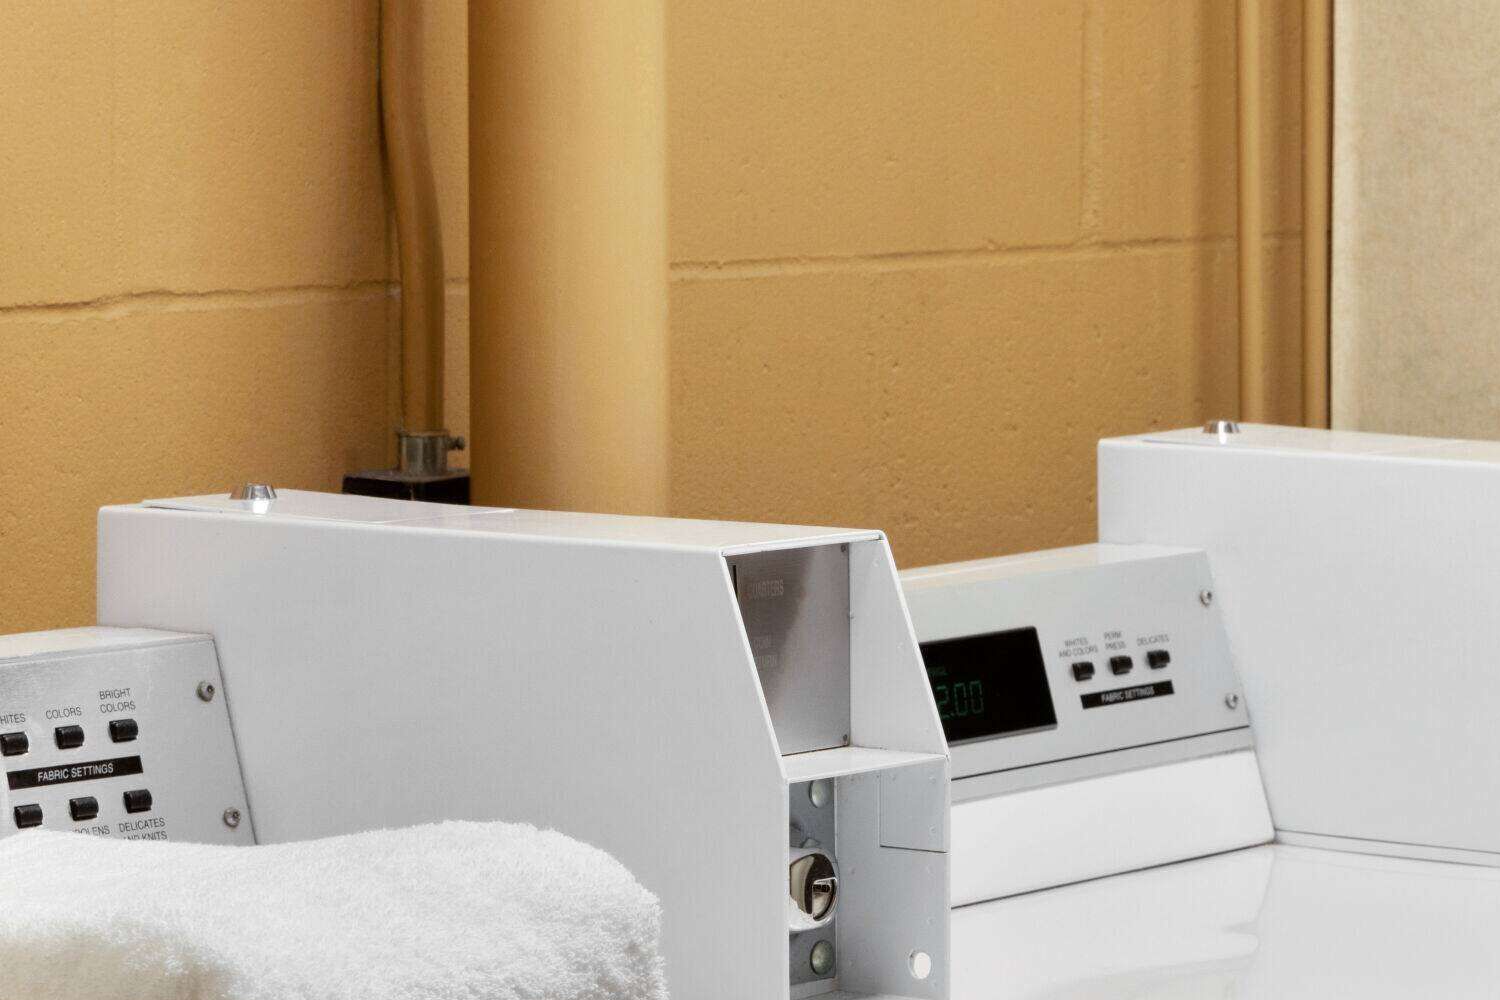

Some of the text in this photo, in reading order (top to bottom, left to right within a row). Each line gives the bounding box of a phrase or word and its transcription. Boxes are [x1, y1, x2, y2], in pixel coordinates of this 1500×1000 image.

[1064, 637, 1088, 647] WHITES
[1137, 633, 1170, 646] DELICATES
[1058, 645, 1099, 658] AND COLORS
[100, 688, 130, 700] BRIGHT
[1101, 684, 1156, 703] FABRIC SETTINGS
[45, 707, 82, 720] COLORS
[100, 701, 136, 714] COLORS
[0, 713, 26, 725] HITES
[37, 762, 114, 783] FABRIC SETTINGS
[118, 818, 166, 833] DELICATES
